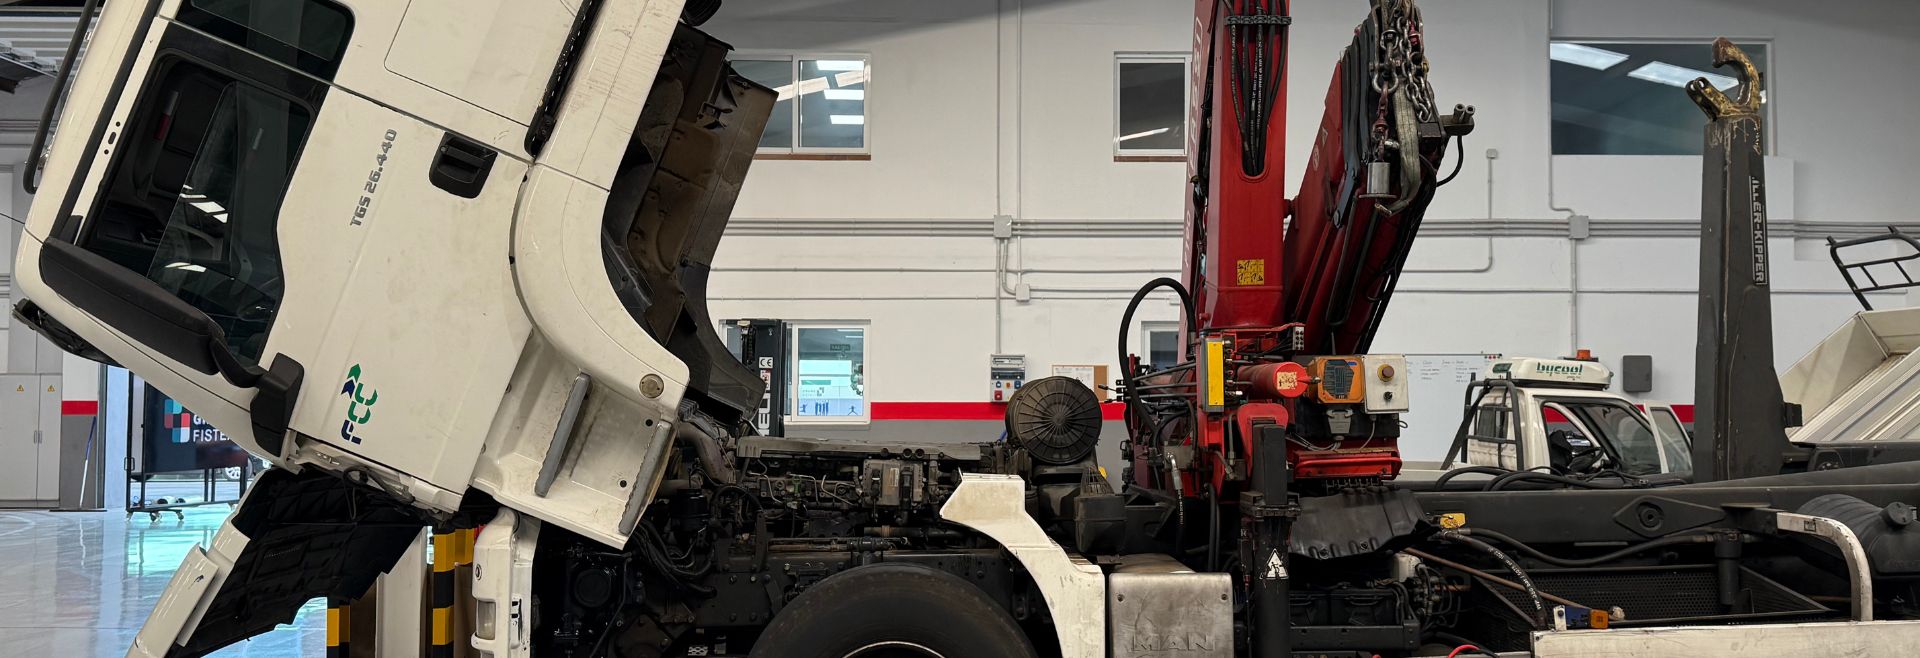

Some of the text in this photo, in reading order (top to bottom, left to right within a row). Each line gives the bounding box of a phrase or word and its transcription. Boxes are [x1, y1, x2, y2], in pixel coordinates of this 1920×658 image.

[349, 128, 397, 226] TGS 26.440
[1751, 176, 1765, 282] ILLER-KIPPER
[760, 358, 772, 368] CE
[192, 428, 230, 442] FISTE
[1131, 632, 1215, 651] MAN
